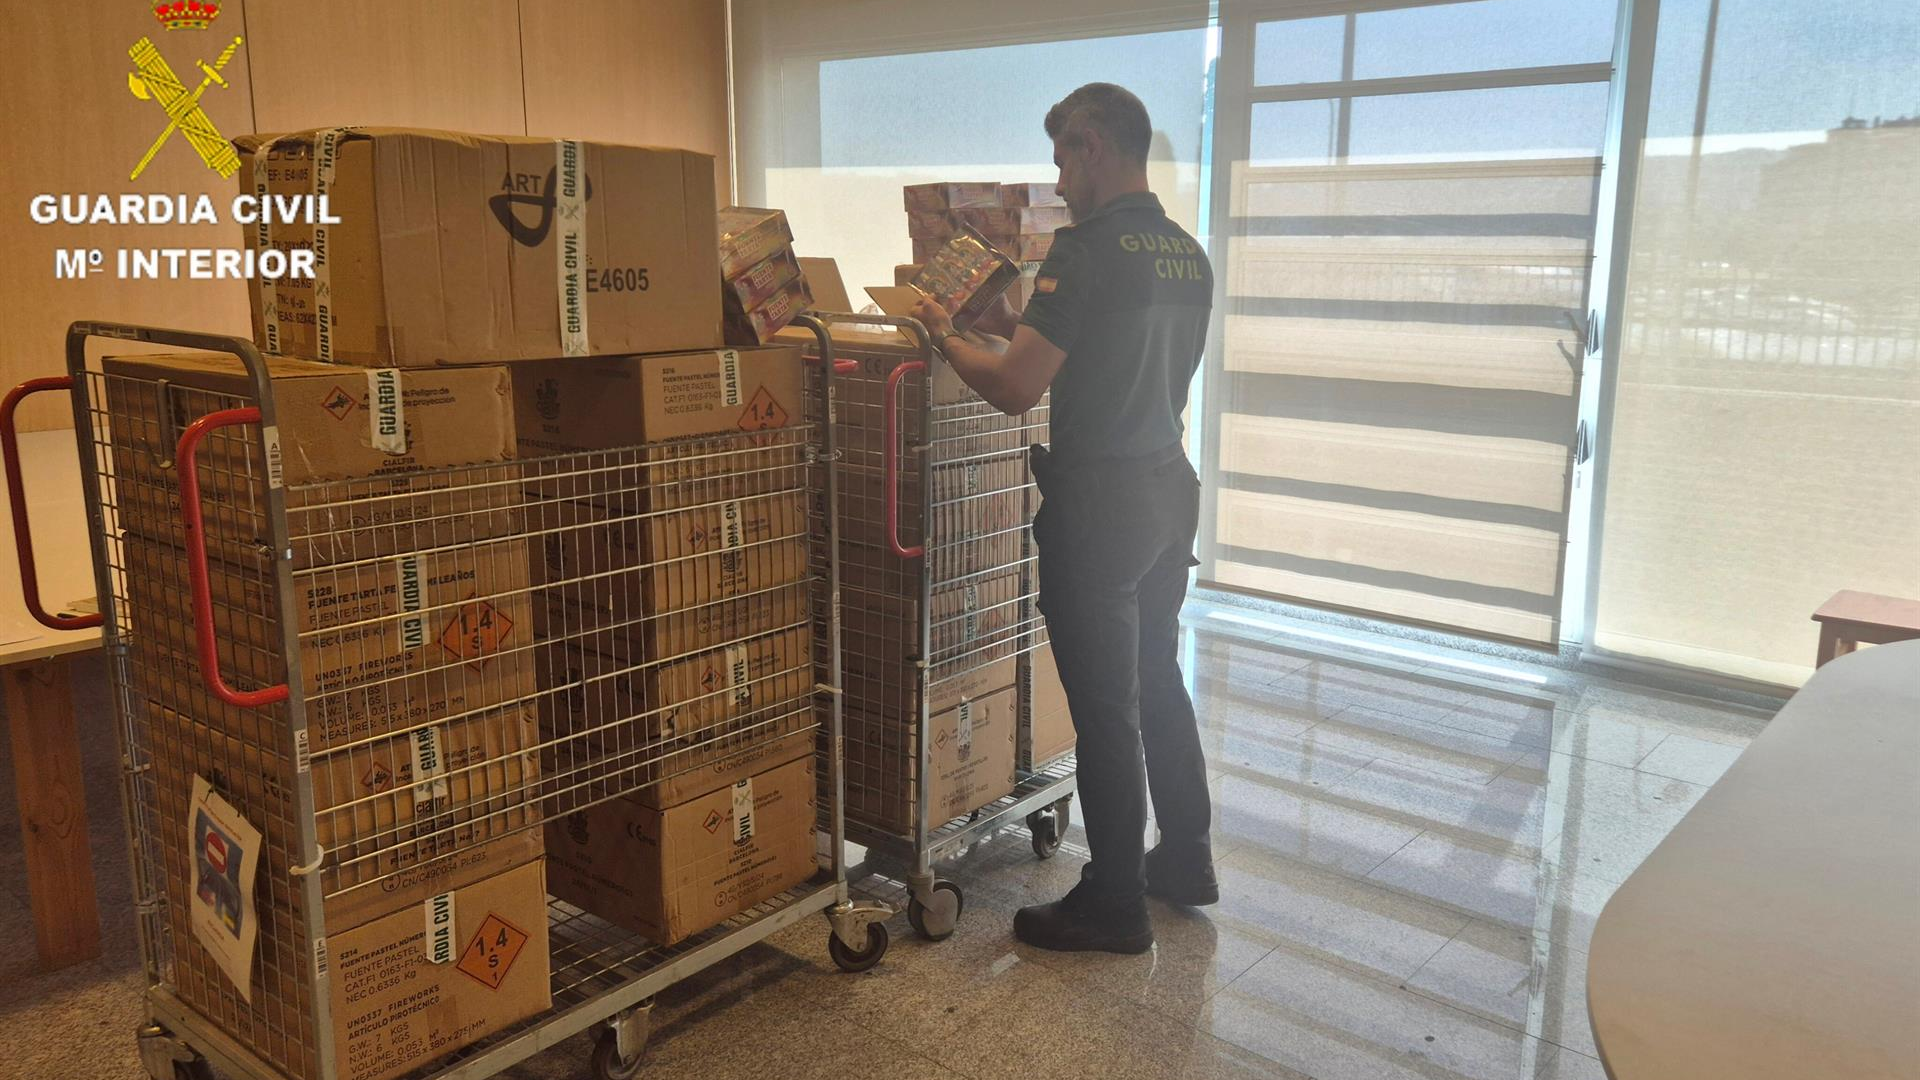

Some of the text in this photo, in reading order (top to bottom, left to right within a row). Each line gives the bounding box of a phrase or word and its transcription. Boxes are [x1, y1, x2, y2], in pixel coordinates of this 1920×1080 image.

[501, 172, 542, 194] ART
[316, 229, 325, 267] CIVIL
[585, 267, 650, 293] E4605
[1154, 257, 1203, 281] CIVIL
[564, 232, 581, 334] GUARDIA CIVIL
[724, 350, 738, 405] GUARDIA
[376, 370, 397, 436] GUARDIA
[751, 401, 775, 422] 1.4
[270, 442, 279, 450] A
[459, 609, 493, 637] 1.4
[475, 928, 509, 957] 1.4
[340, 953, 371, 970] FUENTE
[371, 943, 399, 958] PASTEL
[344, 945, 420, 982] FUENTE PASTEL
[488, 954, 499, 968] S
[346, 989, 367, 1004] NEC
[388, 984, 440, 1013] FIREWORKS
[390, 1022, 410, 1037] KGS
[391, 1031, 411, 1046] KGS
[430, 1036, 447, 1052] 380
[350, 1050, 395, 1074] VOLUME:
